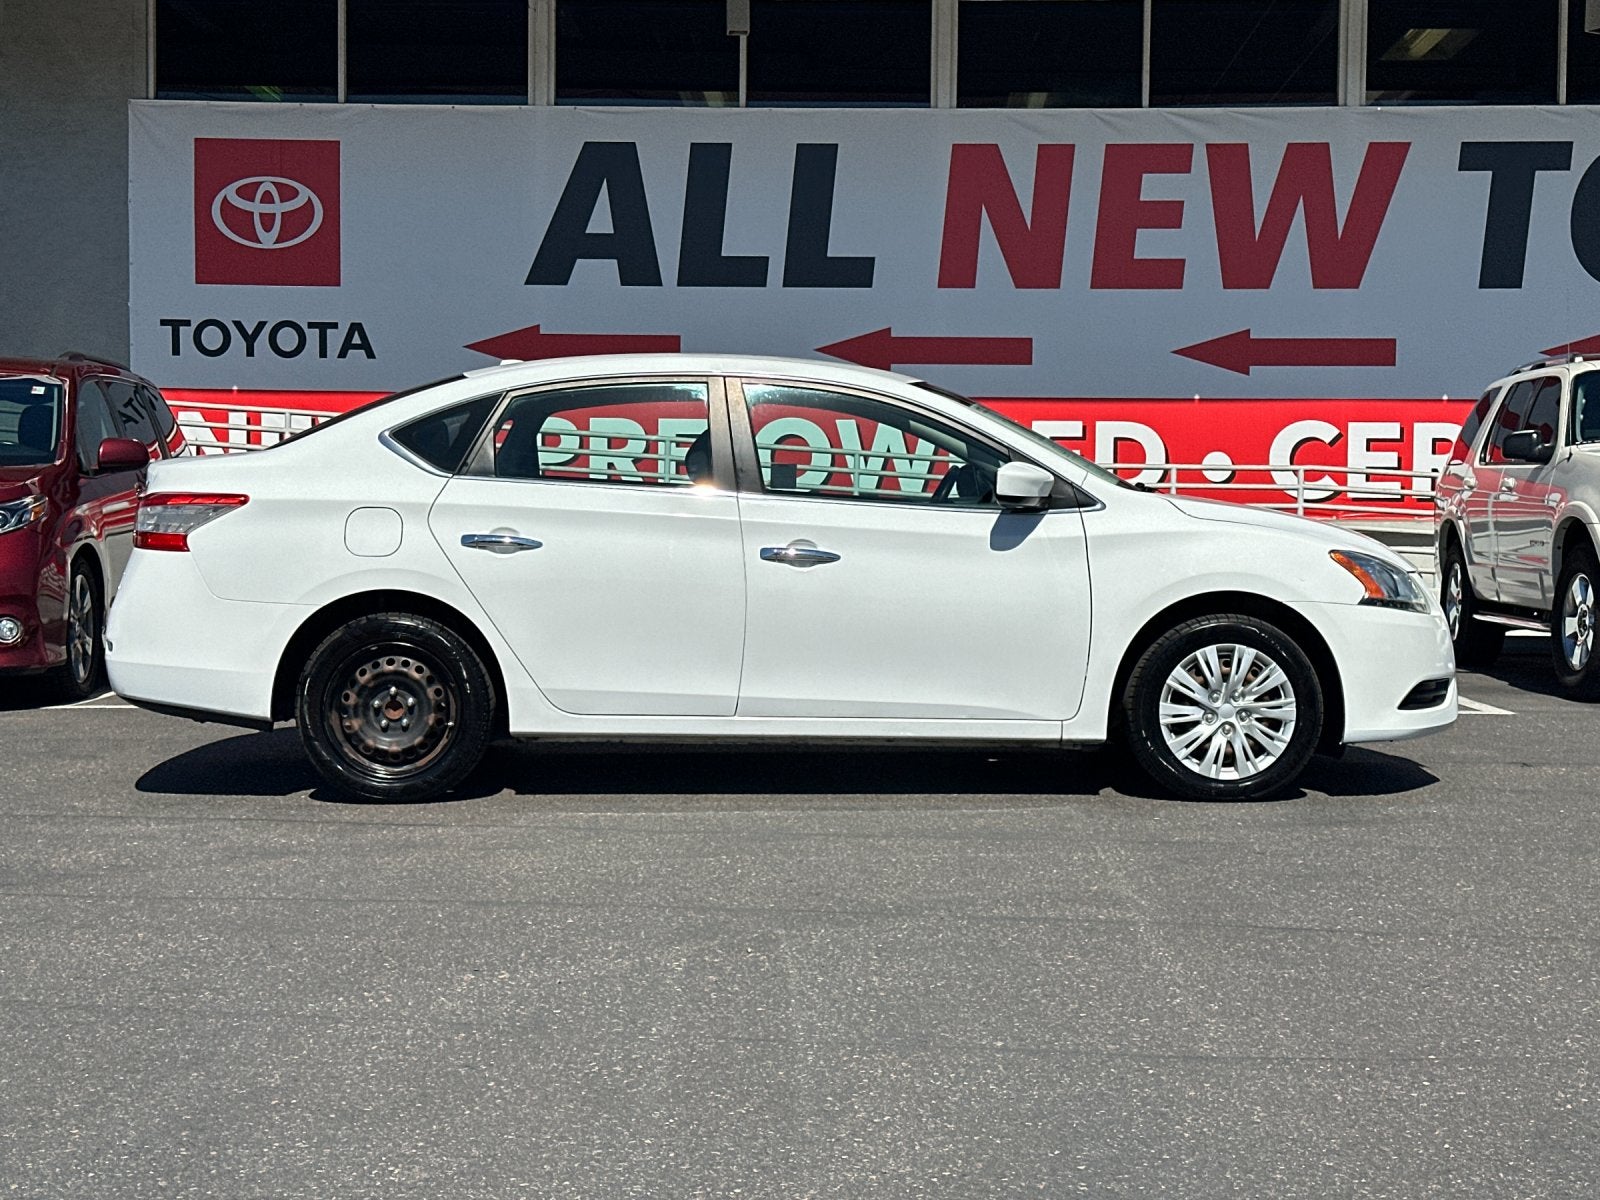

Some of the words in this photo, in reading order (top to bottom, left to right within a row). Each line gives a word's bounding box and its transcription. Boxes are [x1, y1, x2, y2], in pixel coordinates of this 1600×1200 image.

[524, 141, 875, 288] ALL
[938, 141, 1412, 290] NEW
[1458, 141, 1600, 289] T
[159, 318, 377, 359] TOYOTA
